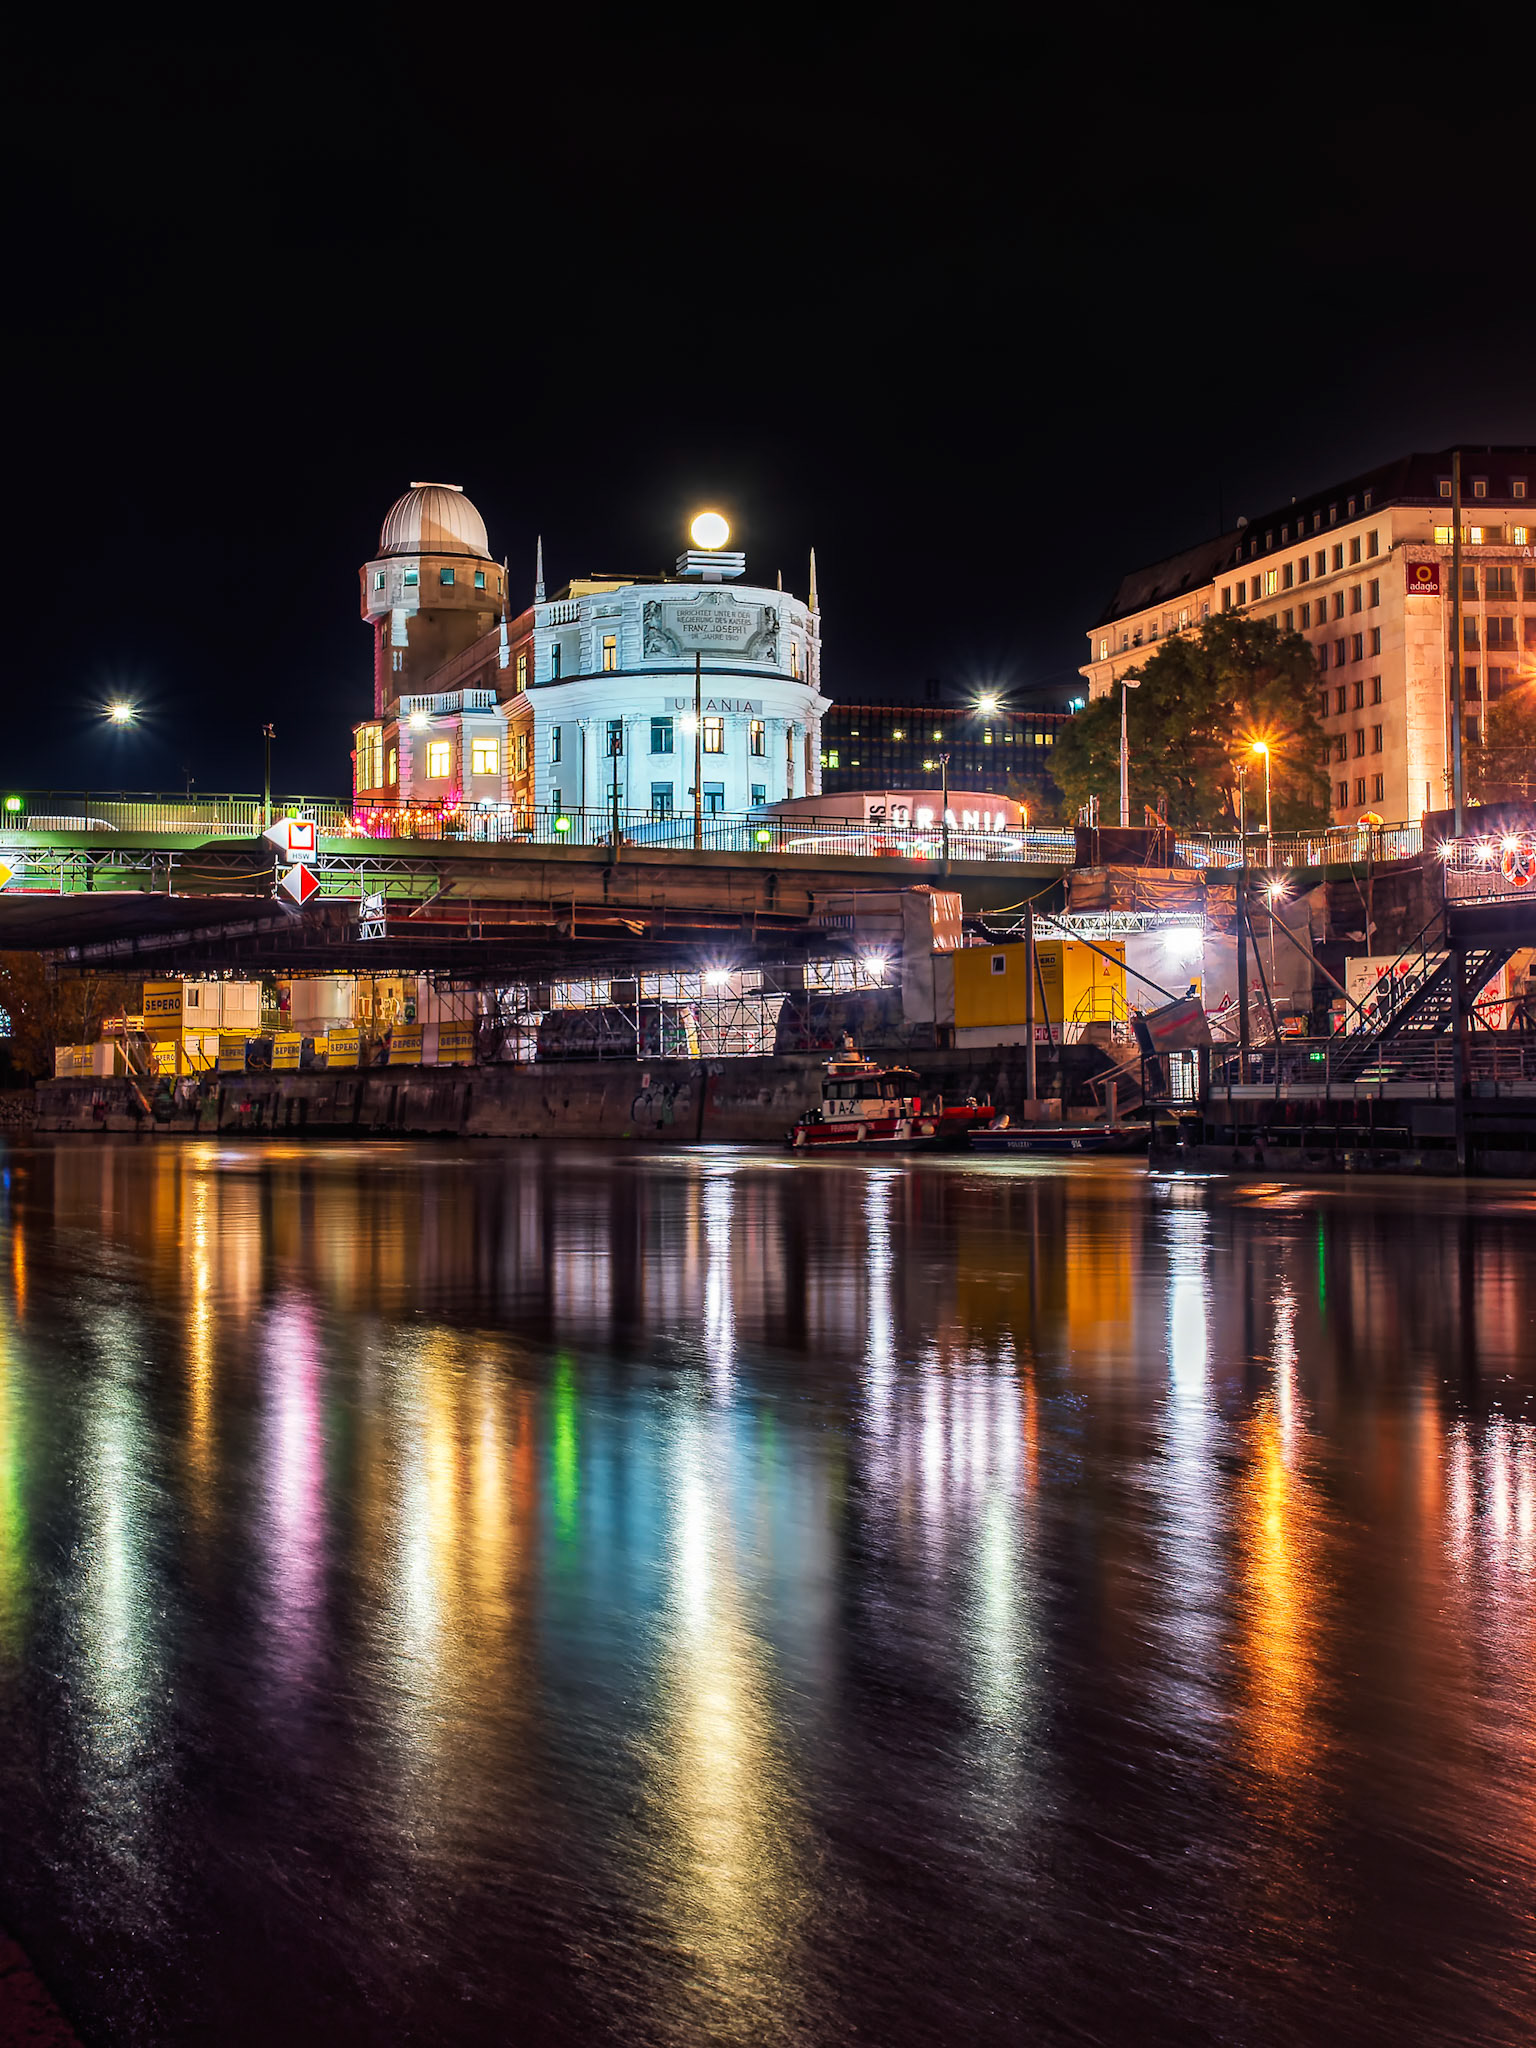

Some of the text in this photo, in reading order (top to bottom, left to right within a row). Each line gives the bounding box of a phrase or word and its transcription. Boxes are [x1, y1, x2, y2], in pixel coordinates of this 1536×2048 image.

[1410, 581, 1439, 593] adagio
[683, 624, 708, 632] FRANZ
[710, 625, 741, 634] JOSEPH
[145, 998, 181, 1011] SEPERO
[331, 1042, 359, 1052] SEPERO
[393, 1039, 421, 1049] SEPERO
